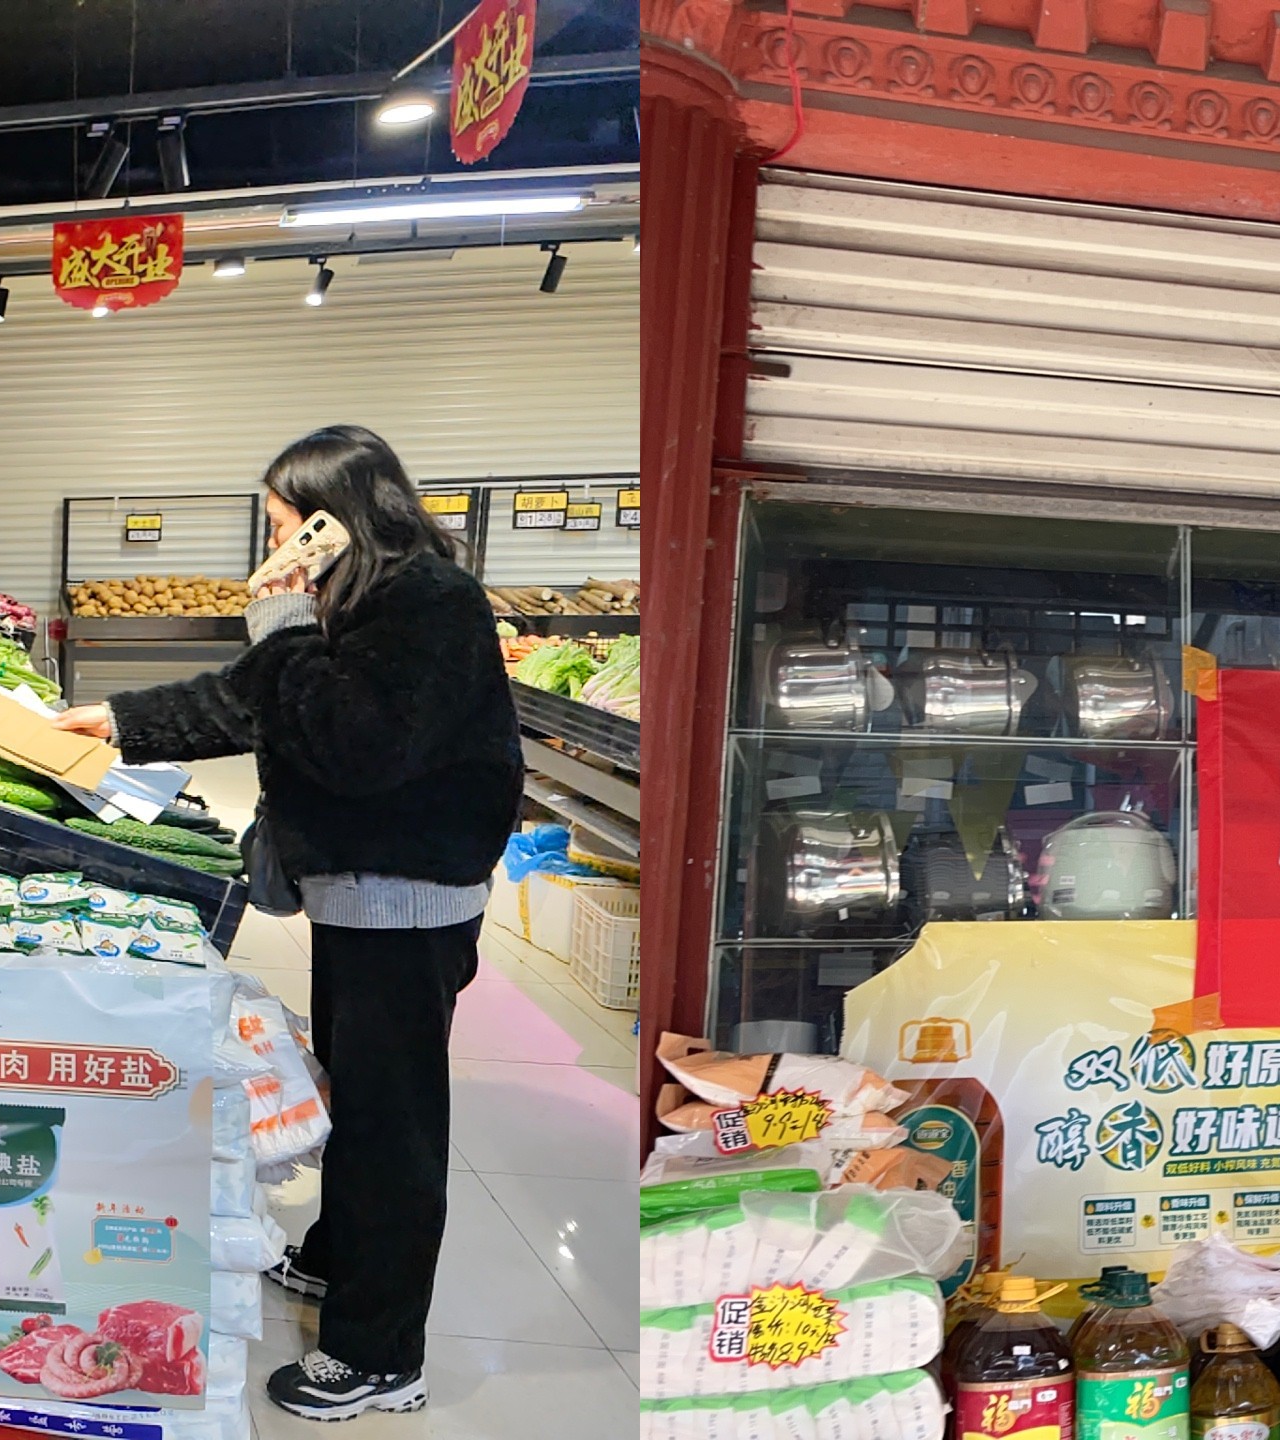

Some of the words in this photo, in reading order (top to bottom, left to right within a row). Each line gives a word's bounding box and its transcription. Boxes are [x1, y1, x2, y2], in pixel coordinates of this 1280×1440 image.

[59, 232, 176, 289] 盛大开业
[521, 496, 560, 510] 胡萝卜
[47, 1048, 154, 1089] 用好盐
[715, 1111, 749, 1149] 促销
[1165, 1162, 1211, 1175] 双低好料
[715, 1301, 749, 1355] 促销
